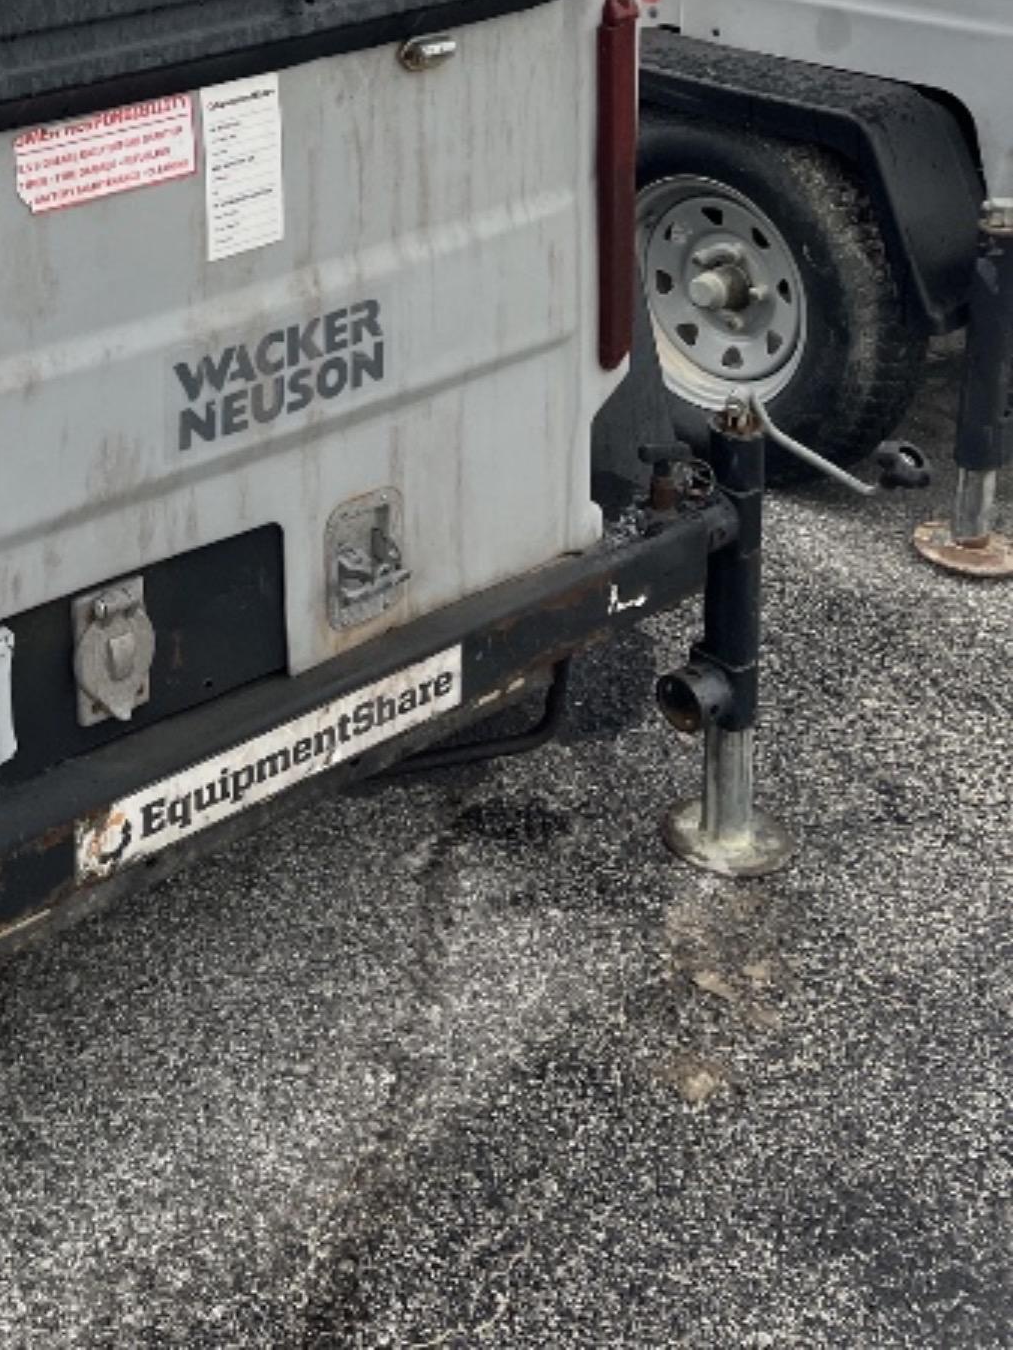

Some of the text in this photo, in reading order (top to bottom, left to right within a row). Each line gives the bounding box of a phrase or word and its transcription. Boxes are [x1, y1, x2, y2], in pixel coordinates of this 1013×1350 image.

[173, 299, 384, 403] WACKER
[178, 341, 385, 451] NEUSON
[140, 670, 454, 838] EquipmentShare
